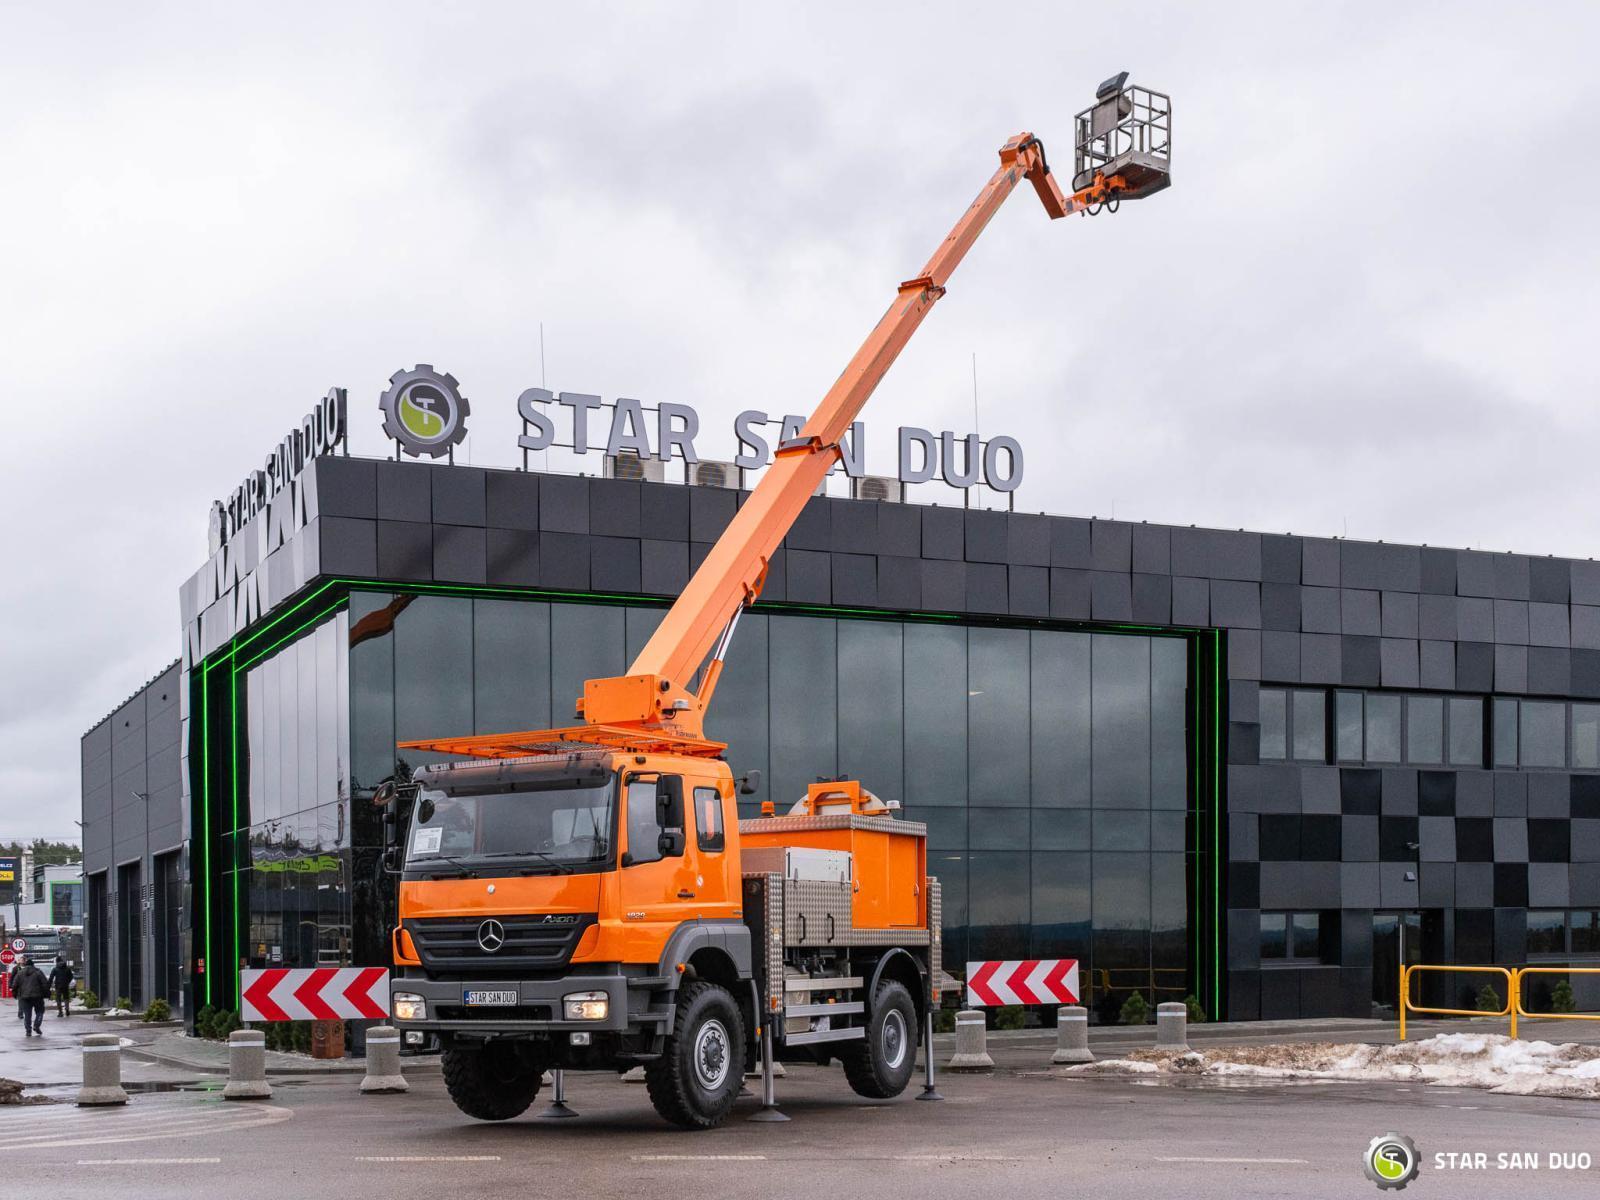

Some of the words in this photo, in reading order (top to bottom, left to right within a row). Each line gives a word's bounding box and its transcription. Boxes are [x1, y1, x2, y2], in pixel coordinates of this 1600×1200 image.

[226, 470, 266, 540] STAR
[265, 429, 301, 505] SAN
[302, 386, 343, 466] DUO
[518, 387, 699, 464] STAR
[898, 426, 1024, 492] DUO
[14, 941, 24, 949] 10
[470, 992, 487, 1003] STAR
[488, 992, 501, 1003] SAN
[502, 992, 516, 1003] DUO
